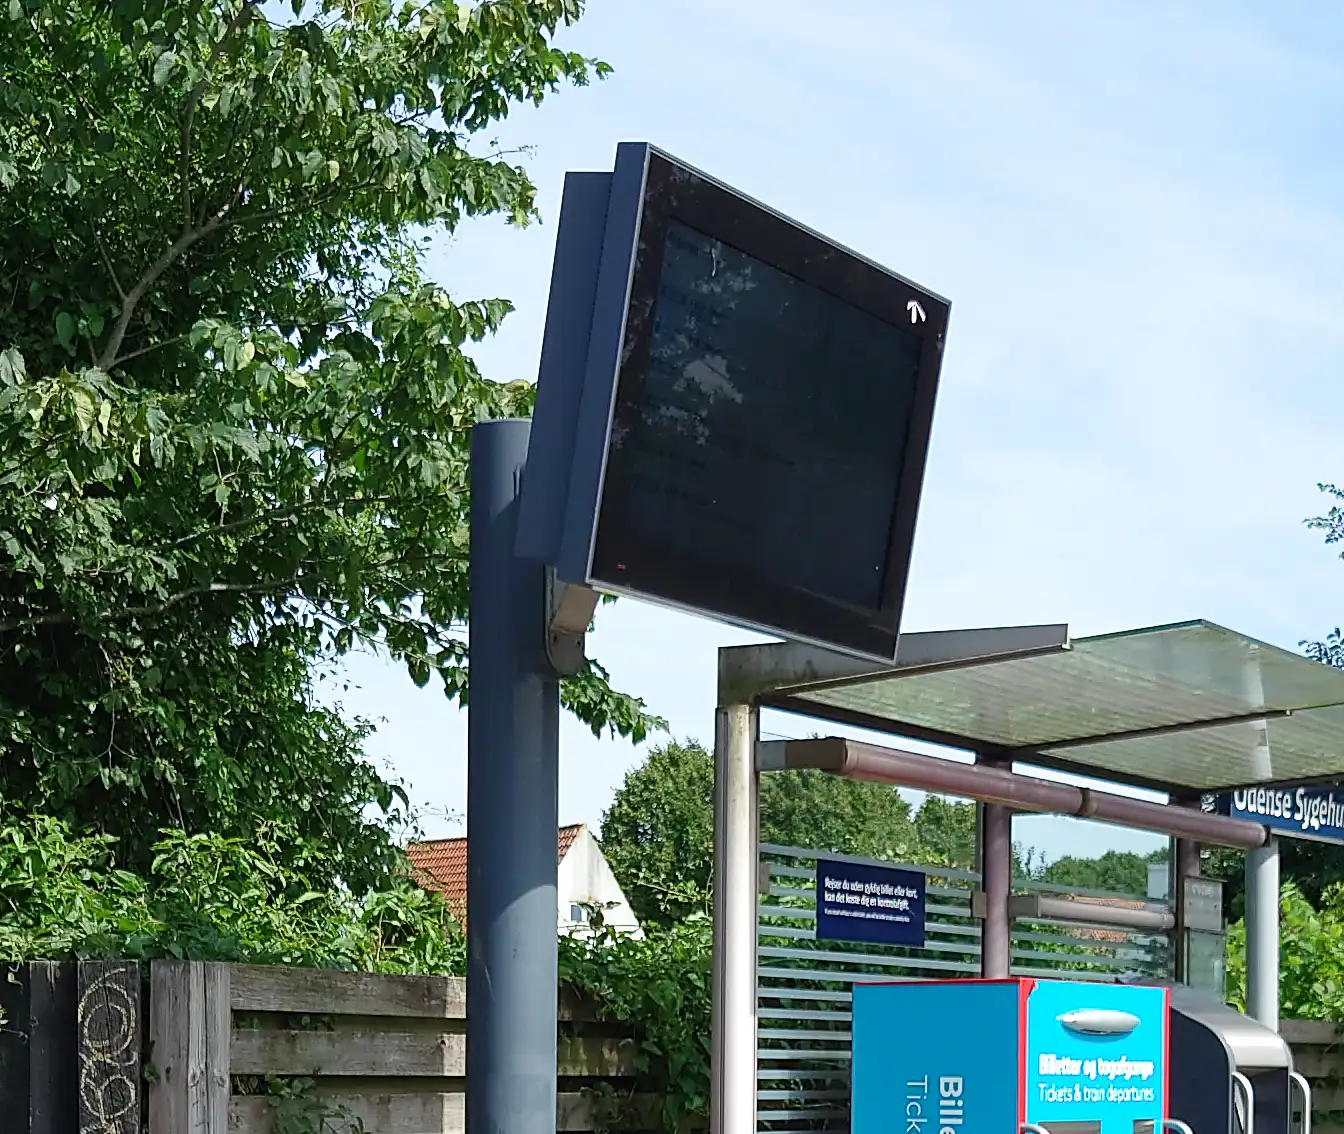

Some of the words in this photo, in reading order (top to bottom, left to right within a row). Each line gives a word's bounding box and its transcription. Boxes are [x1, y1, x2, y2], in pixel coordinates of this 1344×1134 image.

[1038, 1053, 1082, 1076] Billetter
[1083, 1059, 1097, 1081] og
[1097, 1055, 1154, 1081] togafgange
[1037, 1083, 1073, 1102] Tickets
[1074, 1083, 1082, 1102] &
[1083, 1085, 1105, 1102] train
[1106, 1084, 1155, 1105] departures
